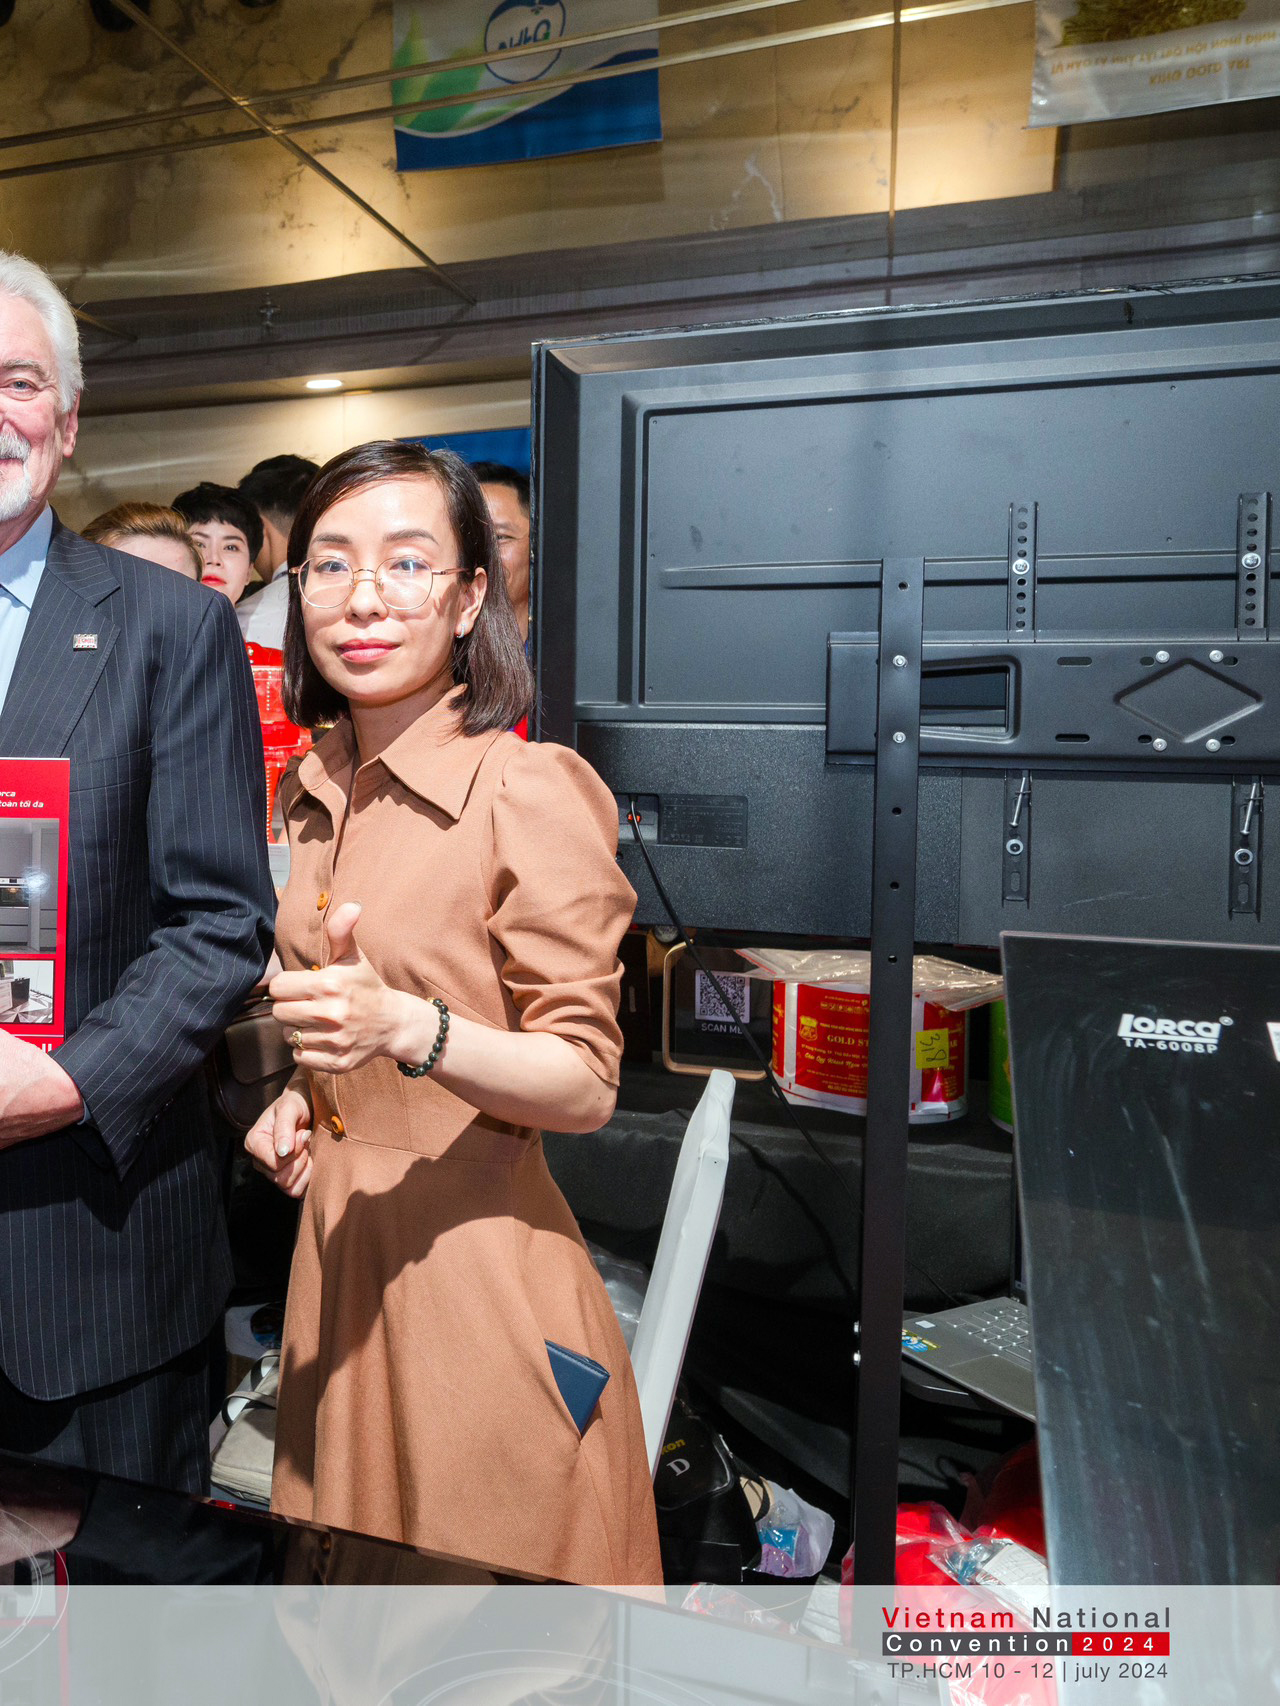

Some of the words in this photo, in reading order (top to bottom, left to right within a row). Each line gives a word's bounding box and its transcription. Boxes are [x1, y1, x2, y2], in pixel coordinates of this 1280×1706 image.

[701, 1023, 727, 1033] SCAN
[827, 1034, 855, 1045] GOLD
[1121, 1037, 1218, 1054] TA-6008P
[662, 1439, 686, 1455] kon
[666, 1458, 691, 1476] D
